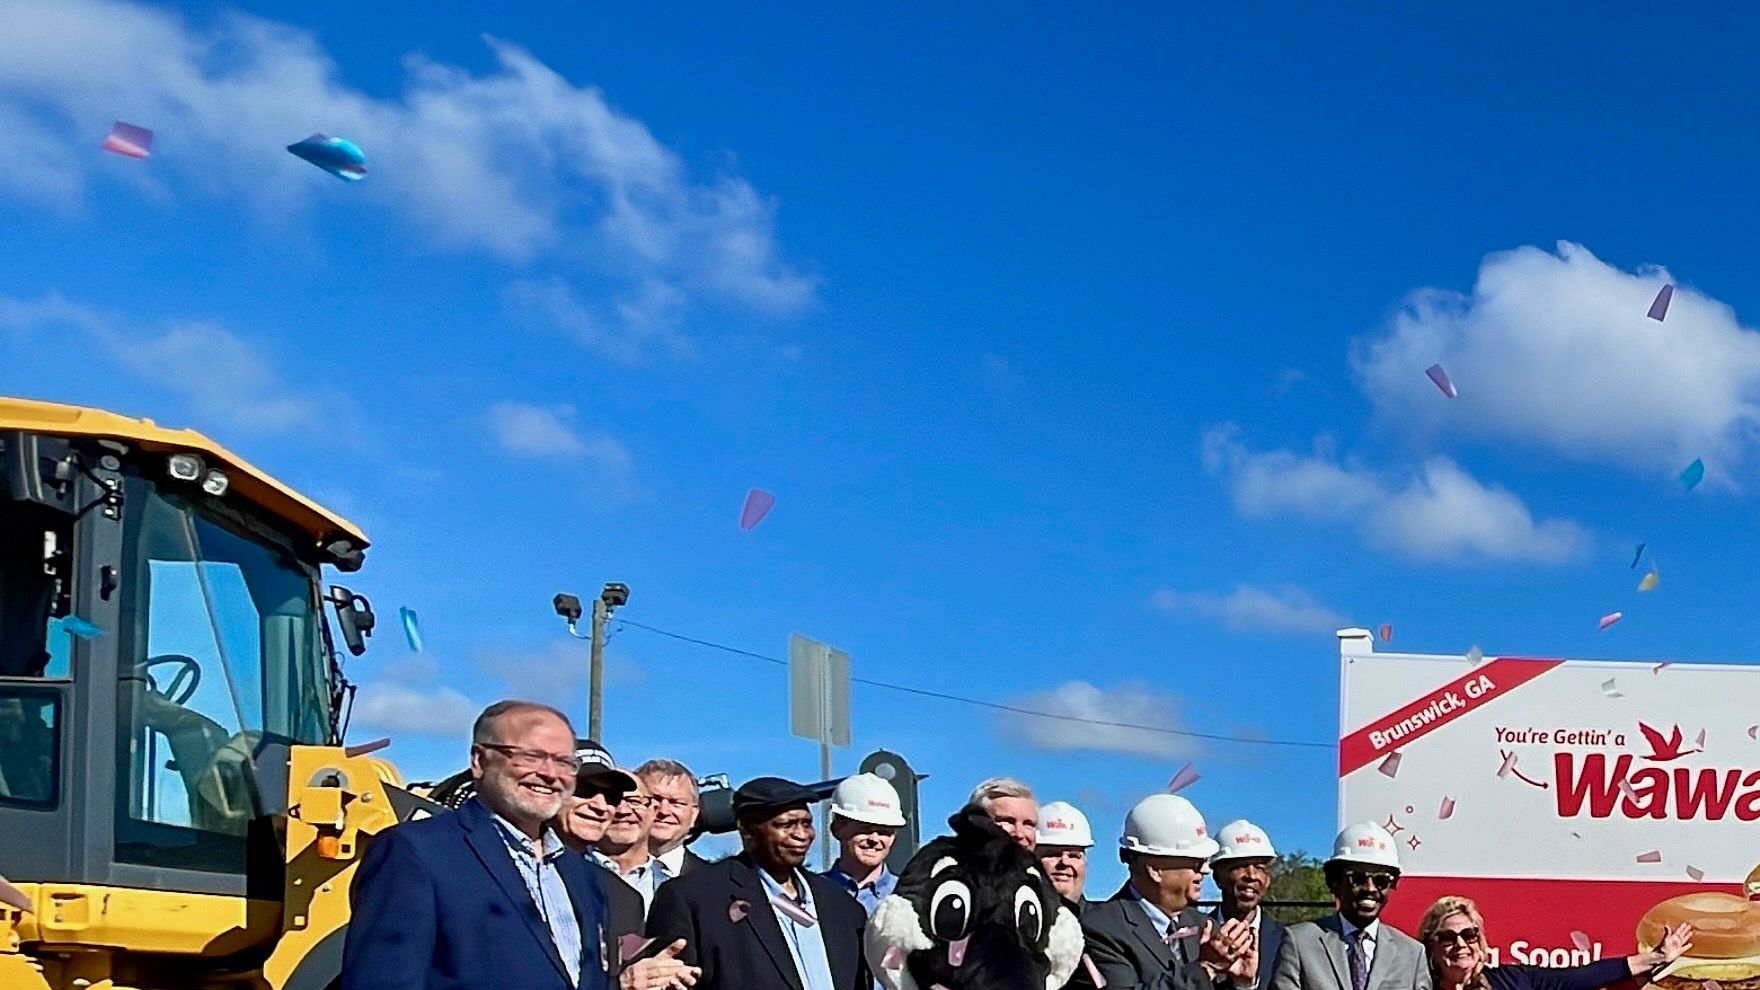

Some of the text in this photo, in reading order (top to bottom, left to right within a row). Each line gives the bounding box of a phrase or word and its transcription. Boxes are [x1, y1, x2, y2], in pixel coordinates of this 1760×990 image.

[1369, 674, 1496, 750] Brunswick, GA
[1495, 727, 1626, 746] You're Gettin' a
[1510, 940, 1602, 969] Soon!
